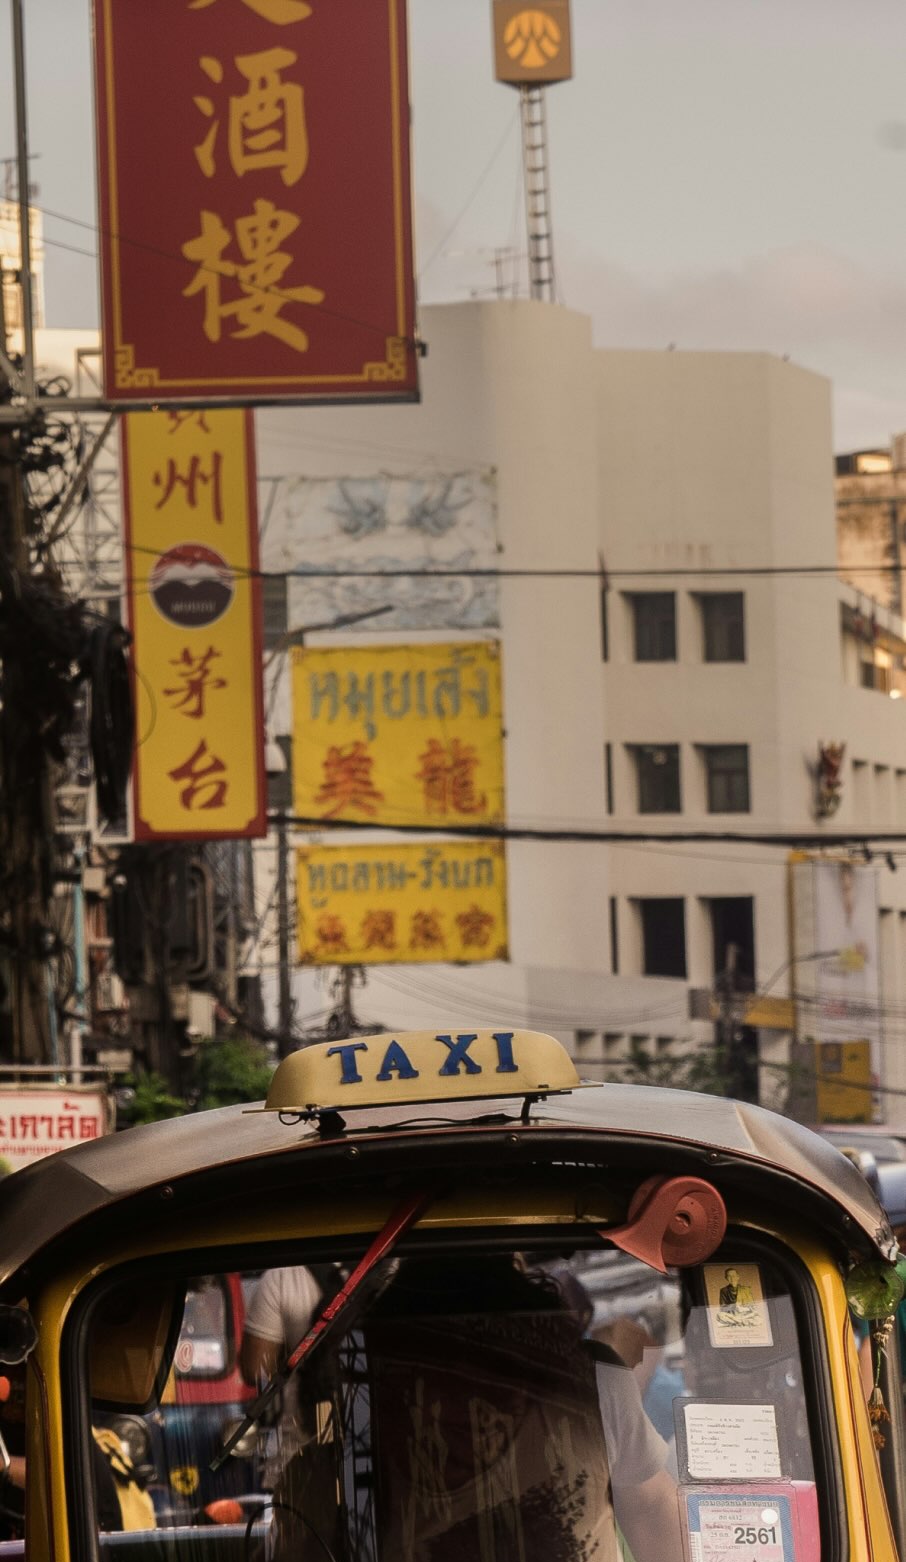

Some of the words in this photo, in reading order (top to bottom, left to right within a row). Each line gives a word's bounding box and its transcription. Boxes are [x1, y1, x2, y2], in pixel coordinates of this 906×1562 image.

[163, 644, 229, 811] 茅台
[327, 1032, 519, 1084] TAXI
[734, 1526, 776, 1545] 2561
